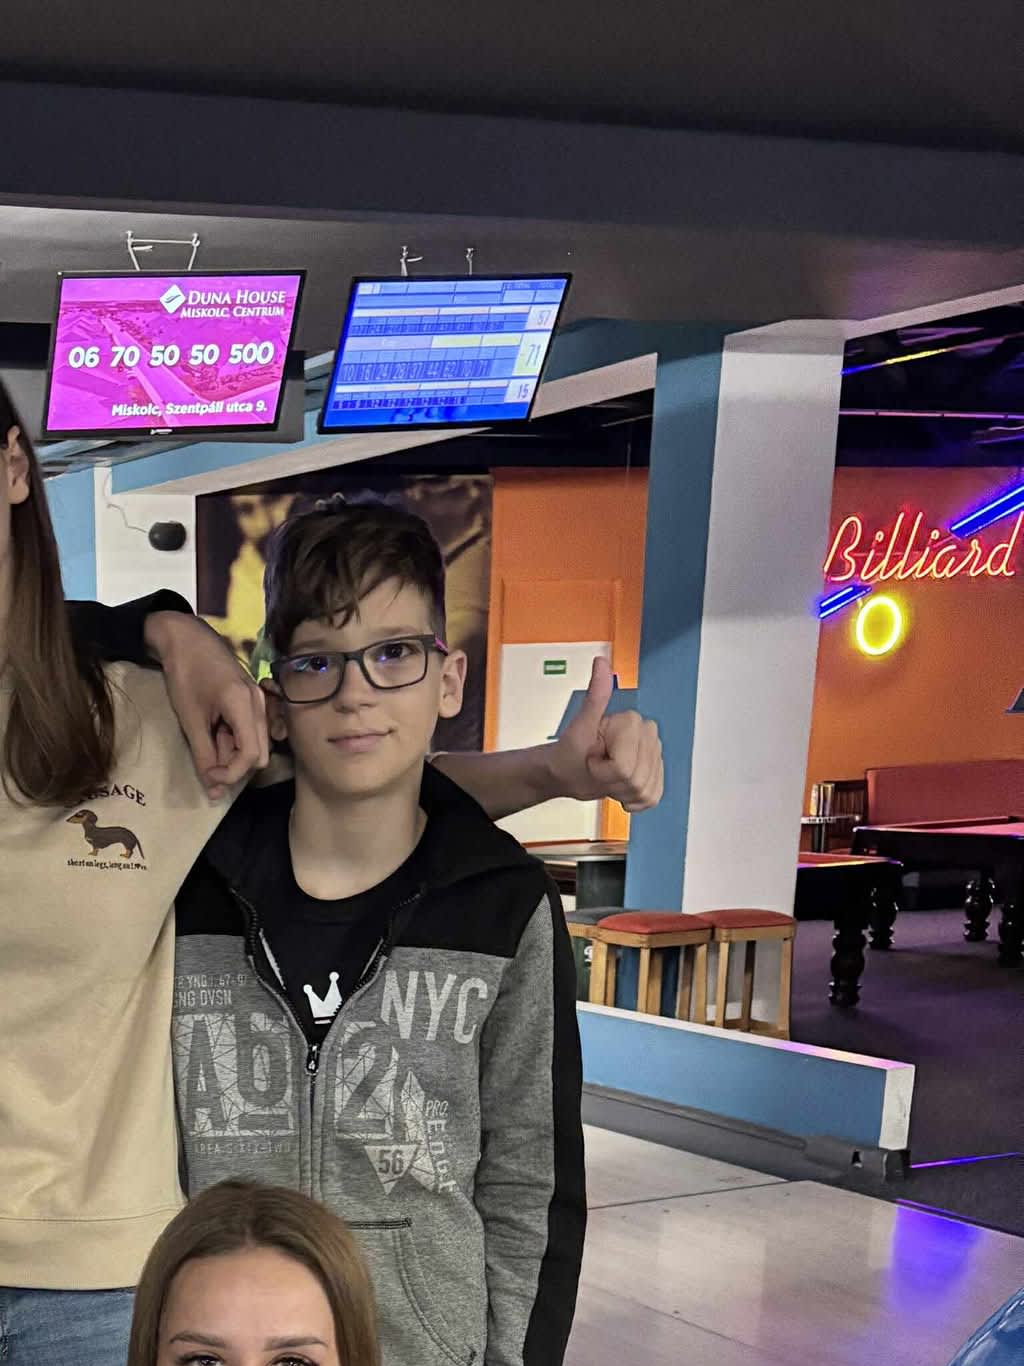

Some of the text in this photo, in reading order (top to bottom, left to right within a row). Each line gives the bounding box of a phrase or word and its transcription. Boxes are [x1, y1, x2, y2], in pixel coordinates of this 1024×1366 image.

[188, 290, 286, 305] DUNA HOUSE
[180, 305, 285, 319] MISKOLC CENTRUM
[68, 342, 275, 368] 06 70 50 50 500
[111, 403, 162, 417] Miskolc,
[227, 401, 253, 413] utca
[255, 400, 268, 412] 9.
[824, 511, 1024, 582] Billiard
[381, 970, 489, 1044] NYC
[377, 1149, 404, 1175] 56
